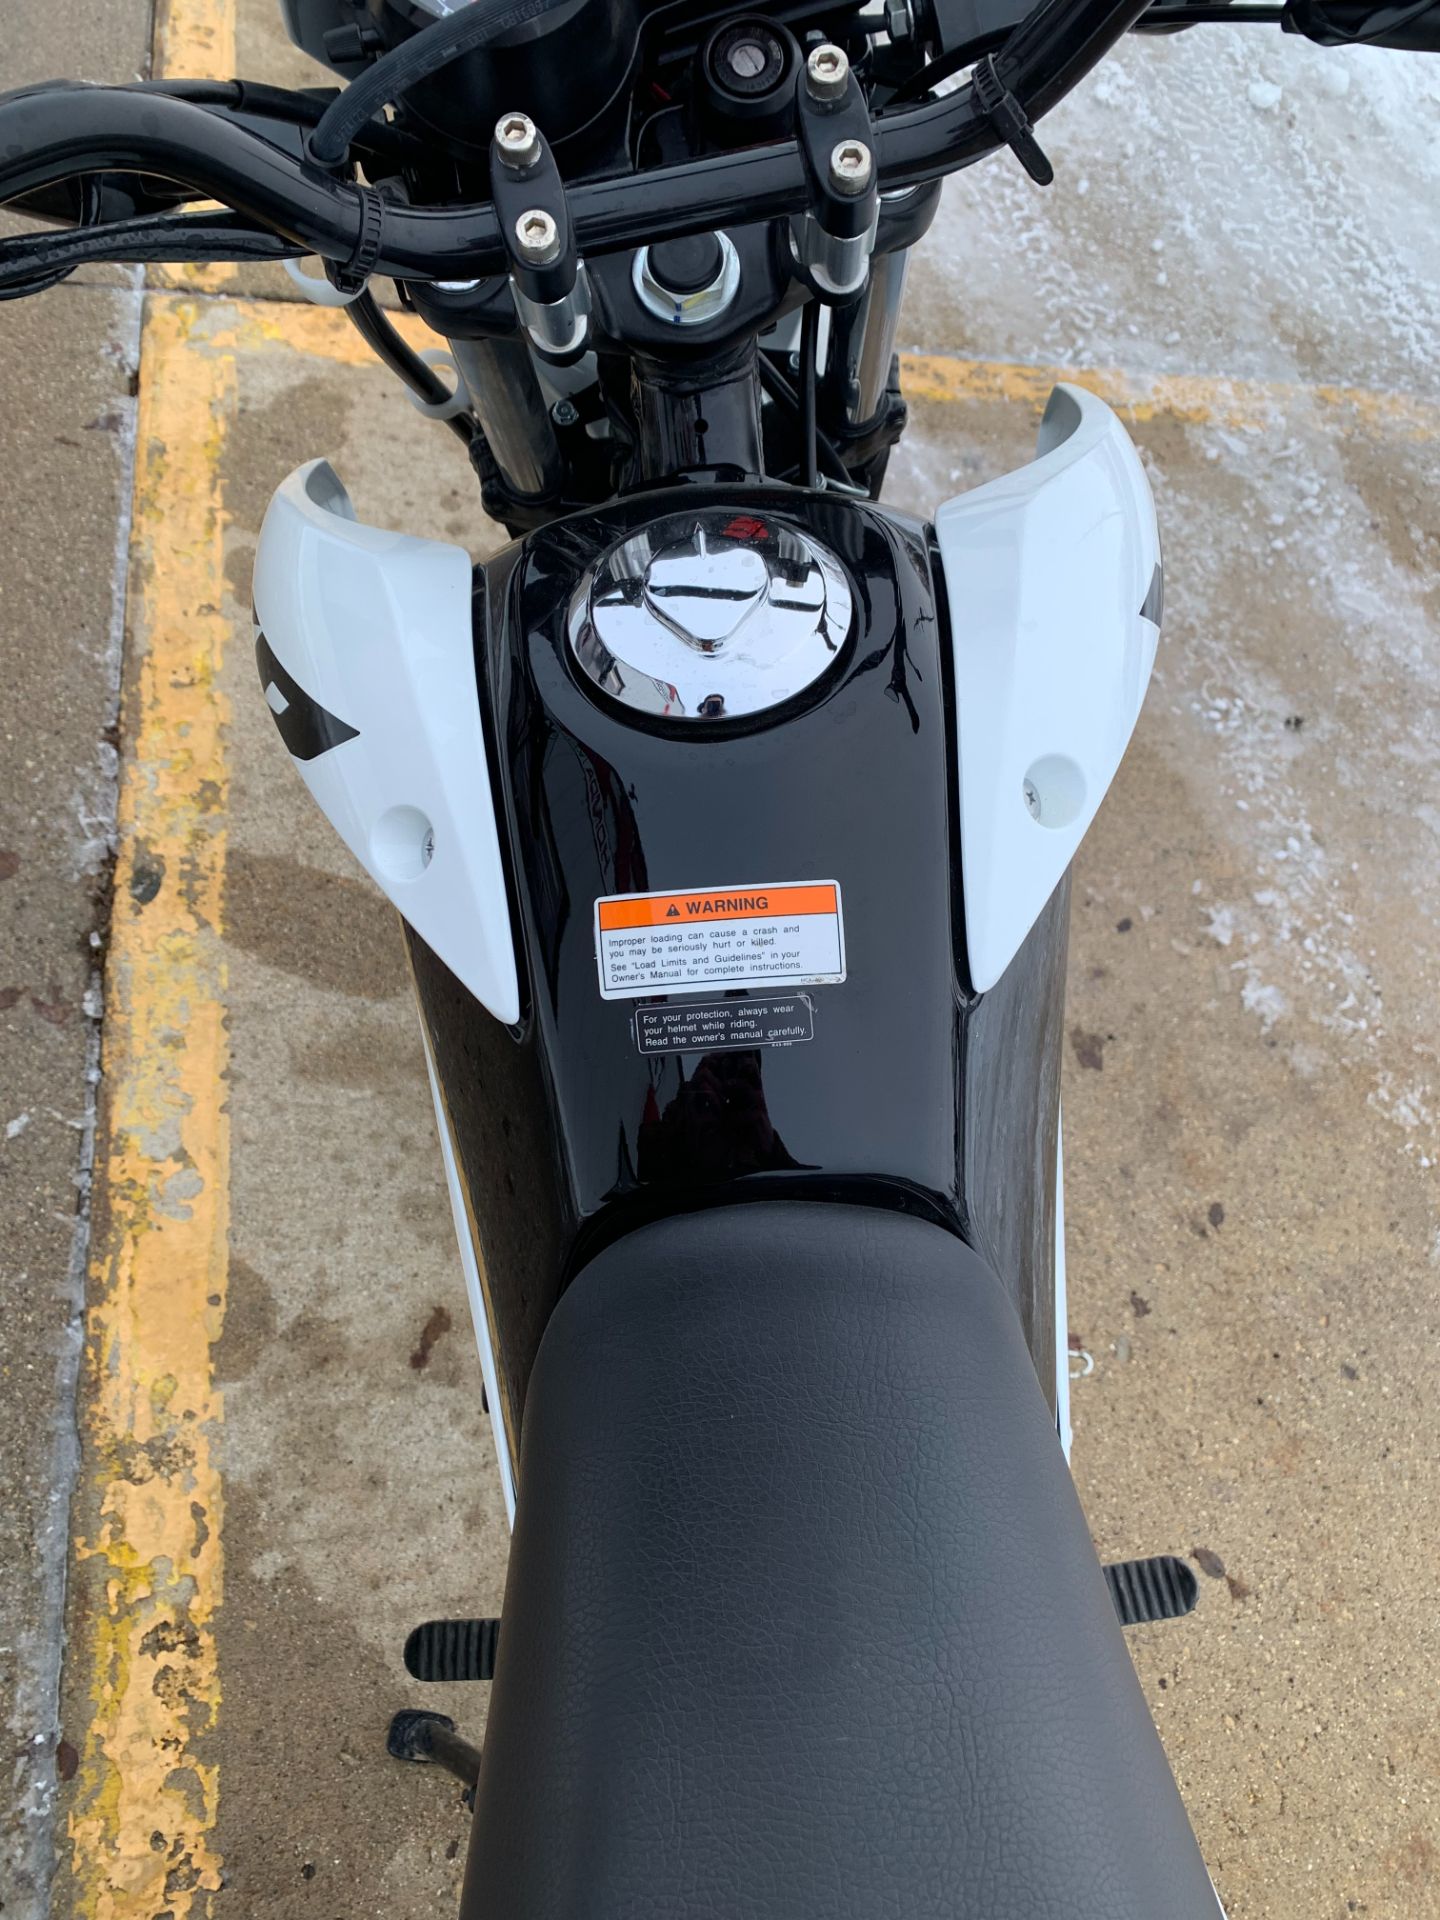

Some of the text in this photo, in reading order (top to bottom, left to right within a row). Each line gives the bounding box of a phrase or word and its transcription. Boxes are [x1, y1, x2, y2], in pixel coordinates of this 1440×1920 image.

[686, 896, 769, 915] WARNING
[609, 937, 646, 947] Improper
[651, 934, 683, 943] loading
[688, 932, 704, 940] can
[710, 929, 736, 938] cause
[753, 926, 778, 935] crash
[783, 925, 800, 933] and
[609, 950, 624, 959] you
[629, 948, 646, 957] may
[652, 946, 662, 954] be
[668, 942, 707, 953] seriously
[713, 941, 731, 949] hurt
[611, 963, 627, 972] See
[661, 958, 687, 967] Limits
[693, 956, 709, 965] and
[771, 951, 778, 959] in
[781, 951, 800, 960] your
[612, 973, 645, 983] Owner's
[650, 969, 681, 979] Manual
[687, 968, 698, 976] for
[704, 965, 744, 975] complete
[643, 1015, 658, 1024] For
[662, 1014, 682, 1024] your
[738, 1007, 768, 1017] always
[773, 1005, 794, 1014] wear
[644, 1019, 757, 1037] your helmet while riding.
[645, 1025, 807, 1047] Read the owner's manual carefully.
